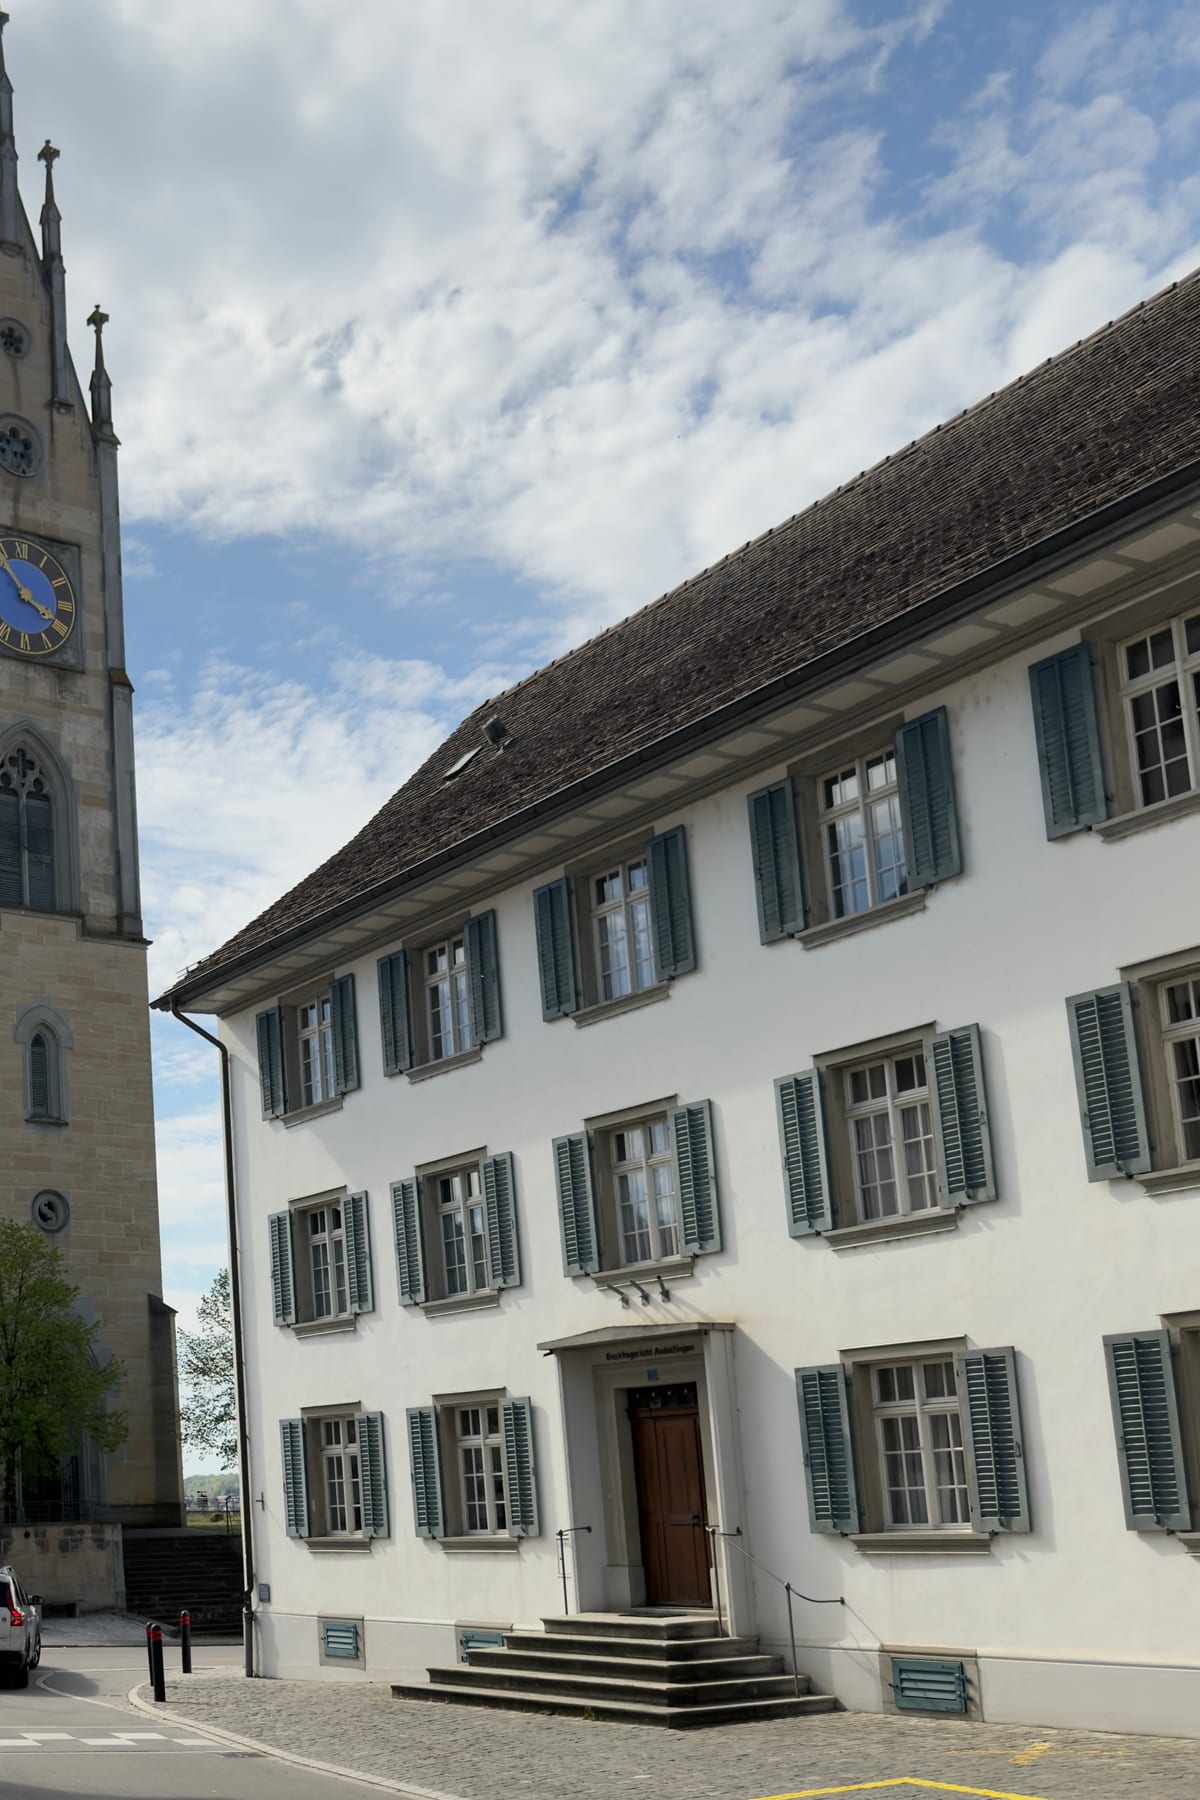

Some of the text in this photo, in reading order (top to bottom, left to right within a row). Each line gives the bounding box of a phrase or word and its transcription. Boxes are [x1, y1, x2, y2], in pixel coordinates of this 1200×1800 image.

[39, 556, 48, 568] I
[52, 577, 66, 588] II
[57, 600, 73, 612] III
[40, 632, 52, 649] V
